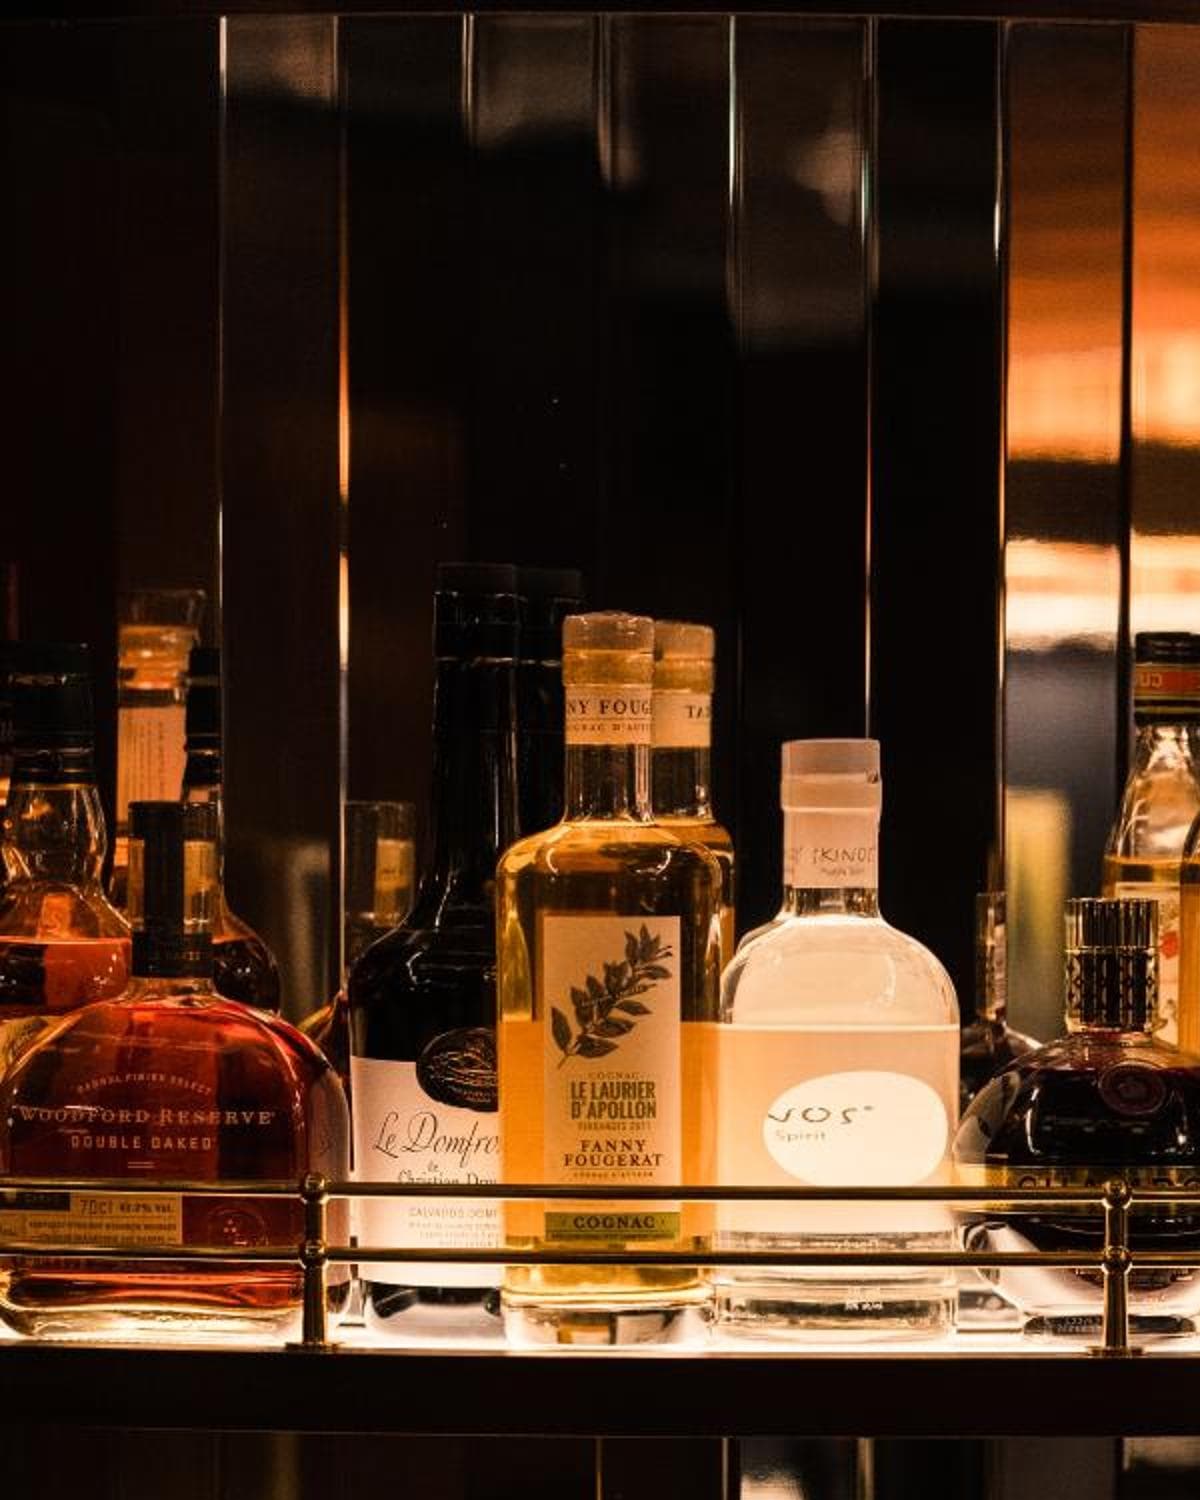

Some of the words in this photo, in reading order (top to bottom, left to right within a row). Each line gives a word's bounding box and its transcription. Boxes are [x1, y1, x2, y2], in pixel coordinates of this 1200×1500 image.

[570, 1081, 587, 1100] LE
[591, 1081, 656, 1100] LAURIER
[19, 1105, 151, 1124] WOODFORD
[159, 1107, 273, 1127] RESERVE
[570, 1100, 657, 1120] D'APOLLON
[70, 1136, 143, 1150] DOUBLE
[374, 1110, 400, 1159] Le
[580, 1139, 646, 1153] FANNY
[563, 1152, 664, 1167] FOUGERAT
[572, 1215, 657, 1230] COGNAC
